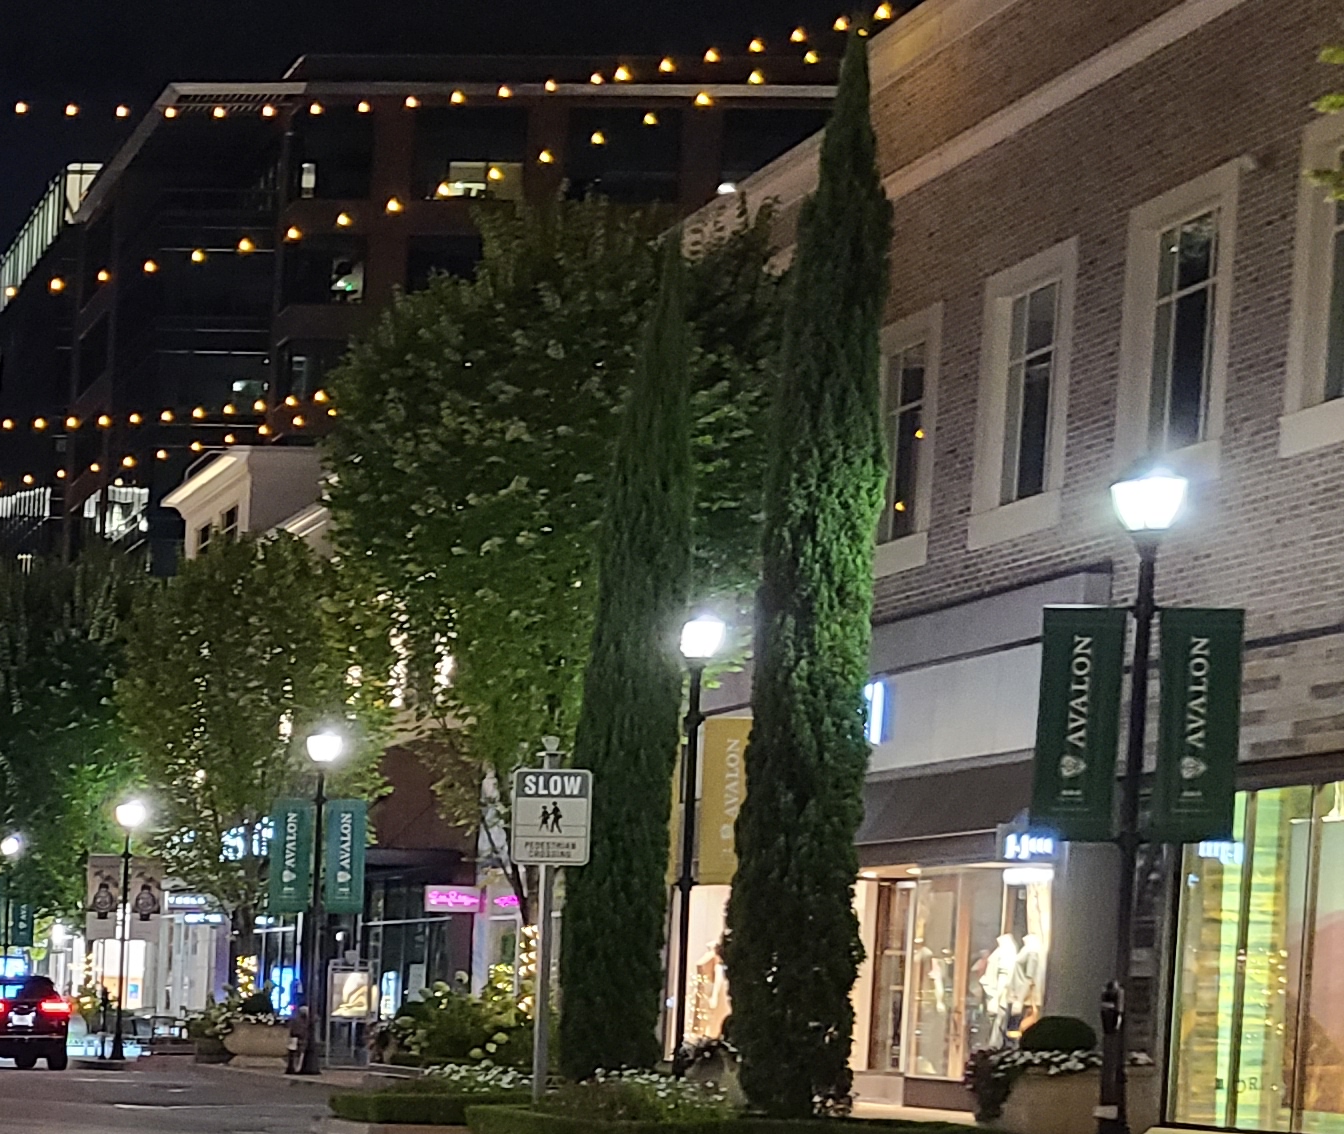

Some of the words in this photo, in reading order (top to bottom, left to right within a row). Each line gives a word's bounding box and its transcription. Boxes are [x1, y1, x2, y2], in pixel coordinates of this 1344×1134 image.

[1066, 634, 1094, 749] AVALON
[1185, 636, 1211, 749] AVALON
[523, 774, 583, 796] SLOW
[724, 738, 741, 818] AVALON
[285, 812, 298, 868] AVALON
[339, 812, 352, 869] AVALON
[524, 841, 576, 850] PEDESTRIAN
[528, 850, 571, 859] CROSSING
